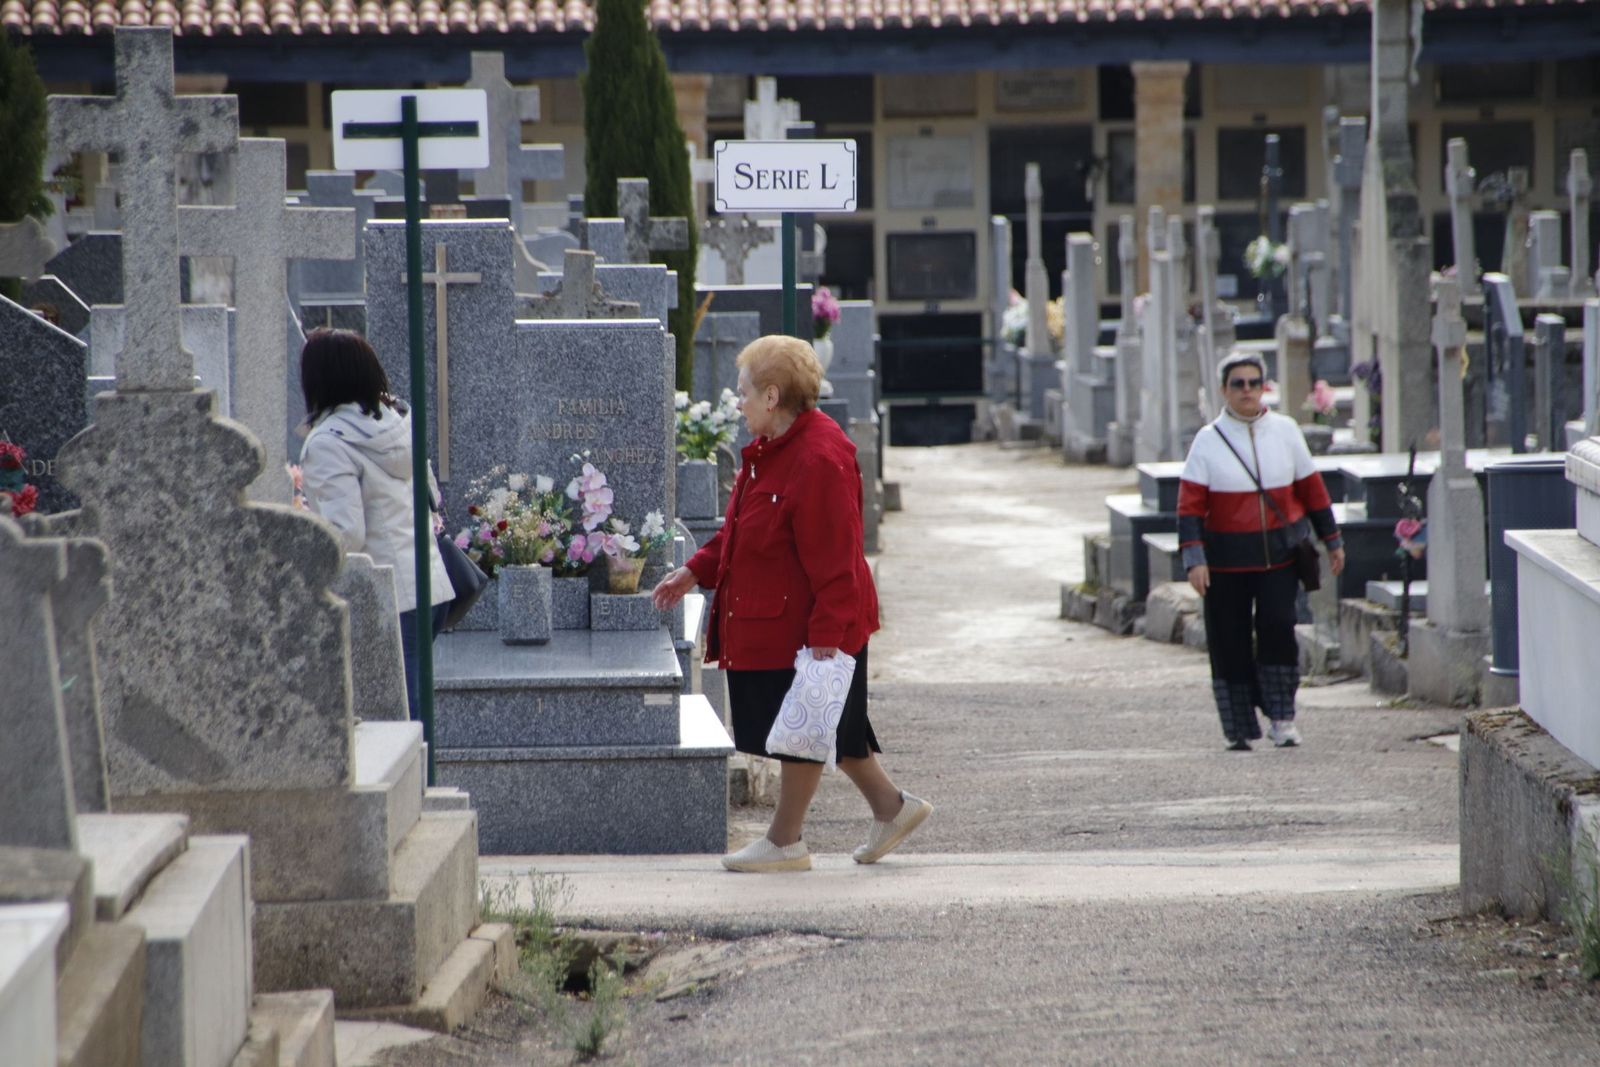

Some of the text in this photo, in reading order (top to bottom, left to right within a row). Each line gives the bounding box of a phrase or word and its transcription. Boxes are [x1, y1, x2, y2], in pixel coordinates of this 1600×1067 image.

[734, 162, 839, 190] SERIE L
[557, 398, 627, 416] FAMILIA
[582, 447, 658, 464] ANCHEZ
